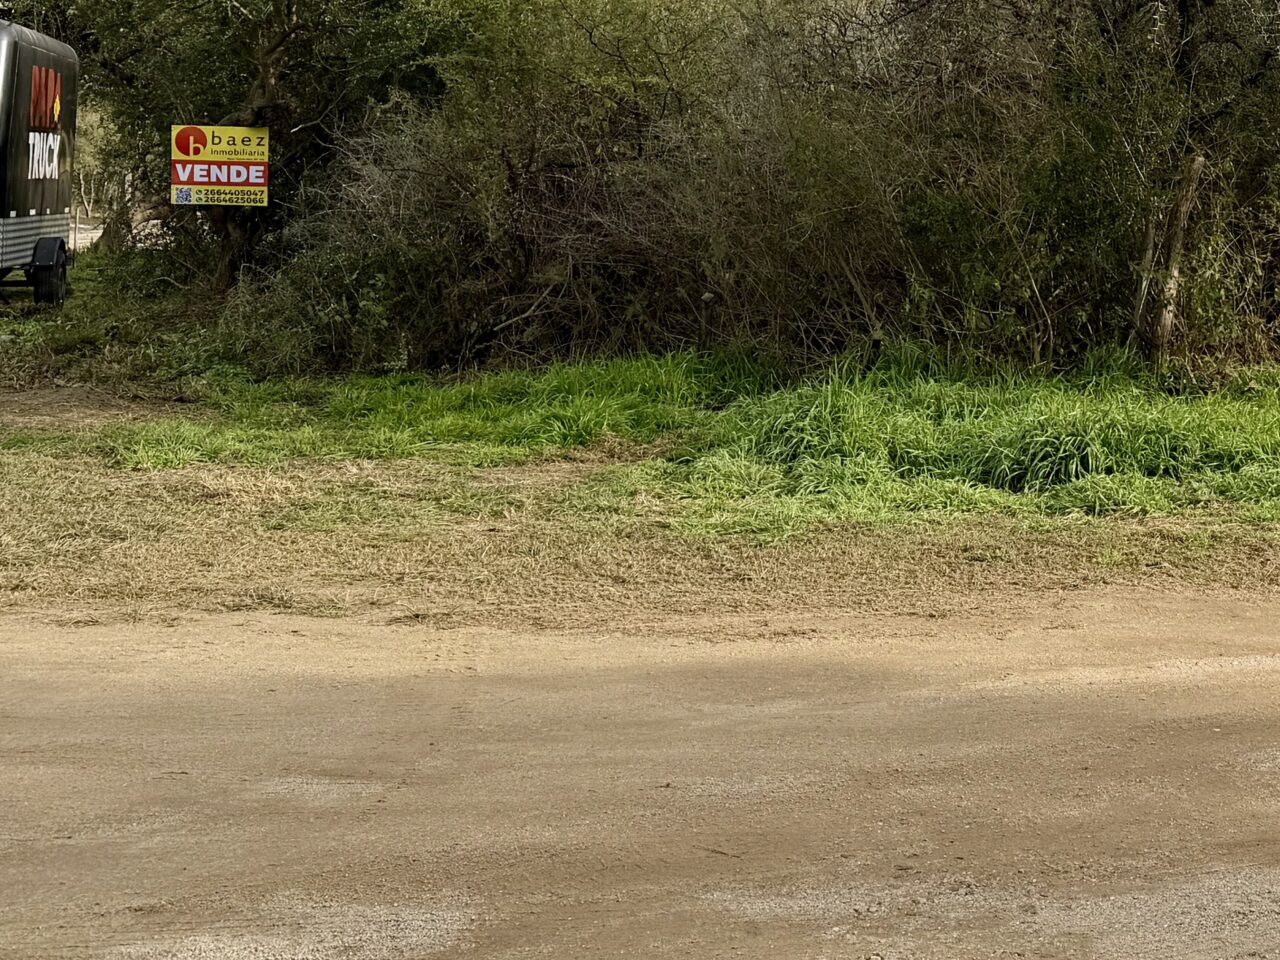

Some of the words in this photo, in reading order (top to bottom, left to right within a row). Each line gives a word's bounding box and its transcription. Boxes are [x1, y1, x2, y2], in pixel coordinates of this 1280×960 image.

[211, 130, 266, 147] baez
[27, 131, 61, 180] TRUCK
[210, 148, 266, 157] Inmobiliaria
[175, 163, 266, 184] VENDE
[203, 189, 265, 197] 2664405047
[203, 196, 265, 205] 2664625066
